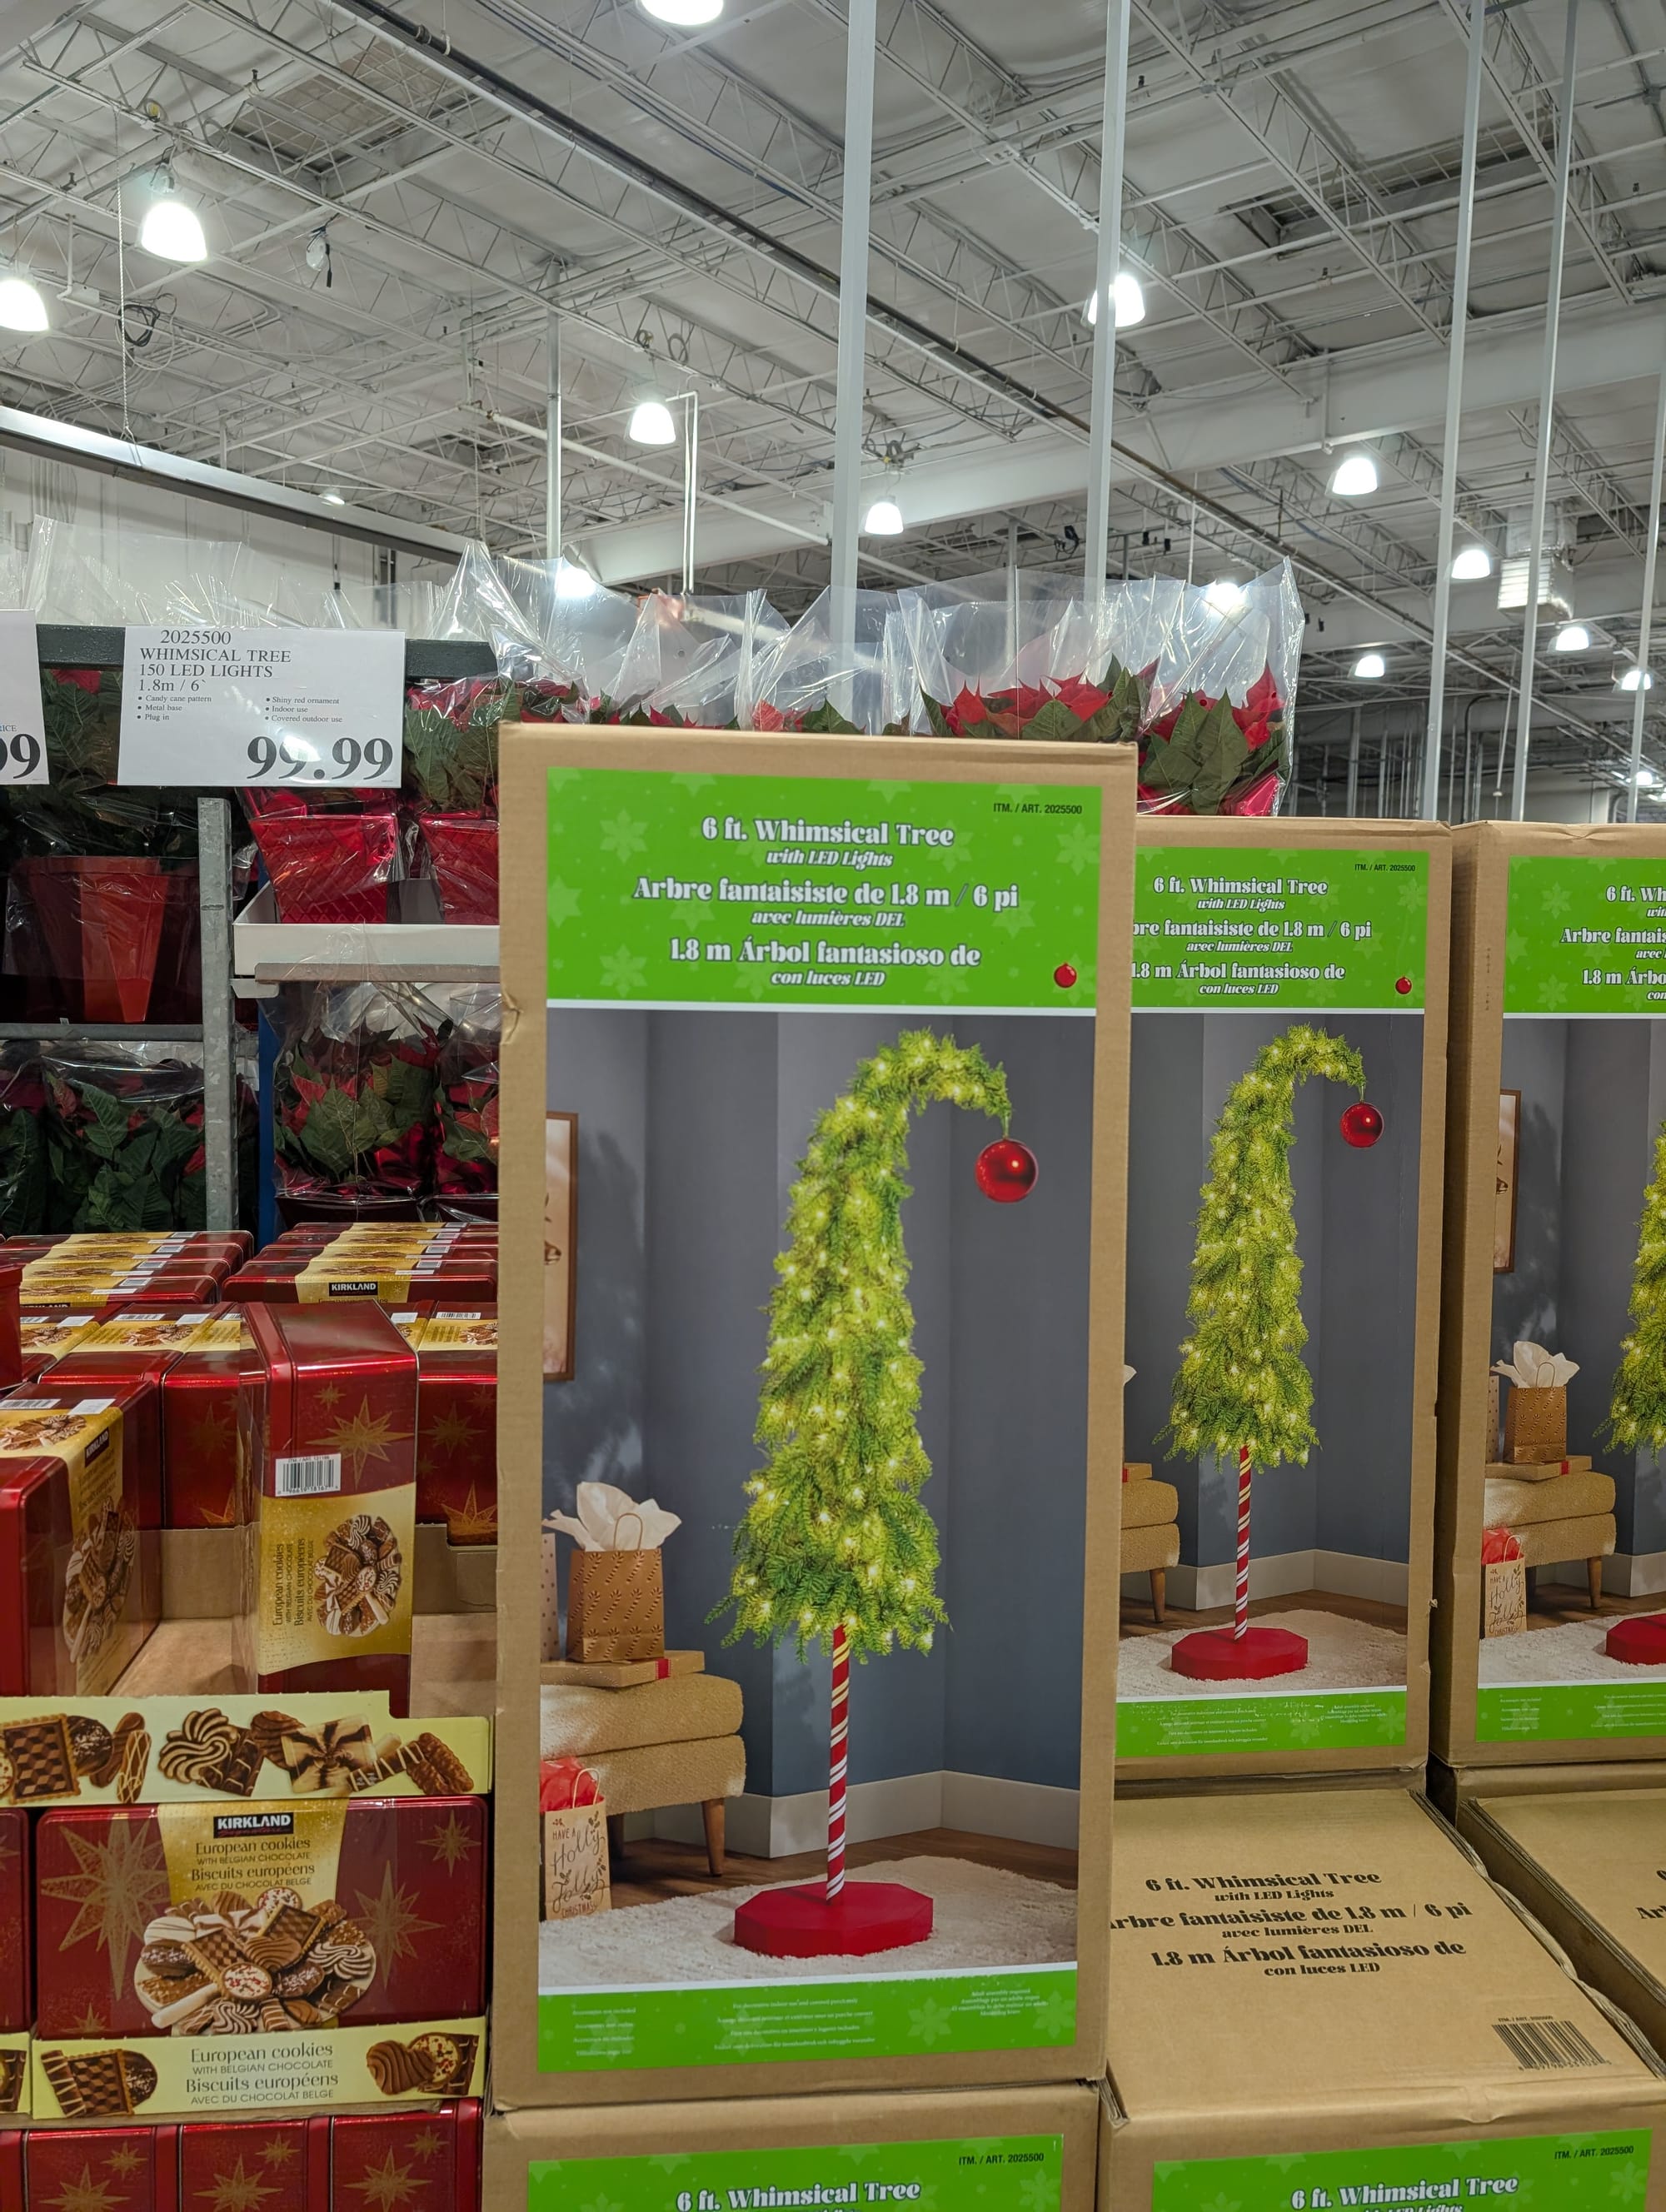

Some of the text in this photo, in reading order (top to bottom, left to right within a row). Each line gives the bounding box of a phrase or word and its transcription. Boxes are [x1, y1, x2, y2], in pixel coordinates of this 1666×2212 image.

[160, 630, 232, 645] 2025500
[140, 648, 292, 663] WHIMSICAL TREE
[140, 664, 272, 678] 150 LED LIGHTS
[139, 679, 174, 691] 1.8m
[145, 695, 167, 704] Candy
[187, 695, 212, 704] pattern
[272, 696, 292, 705] Shiny
[145, 714, 161, 722] Plug
[247, 736, 393, 780] 99.99
[993, 803, 1012, 813] ITM.
[1021, 804, 1041, 814] ART.
[1045, 805, 1082, 815] 2025500
[701, 816, 955, 847] 6 ft. Whimsical Tree
[766, 849, 894, 871] with LED Lights
[1153, 875, 1329, 895] 6 ft. Whimsical Tree
[1606, 885, 1635, 902] 6 ft.
[633, 876, 713, 901] Arbre
[718, 877, 848, 904] fantaisiste
[854, 882, 885, 906] de
[890, 883, 919, 906] 1.8
[925, 889, 950, 906] m
[972, 884, 989, 908] 6
[993, 884, 1019, 913] pi
[1197, 897, 1286, 913] with LED Lights
[751, 909, 905, 928] avec lumières DEL
[1164, 919, 1254, 937] fantaisiste
[1257, 920, 1279, 937] de
[1283, 920, 1304, 937] 1.8
[1306, 924, 1324, 937] m
[1339, 921, 1351, 938] 6
[1354, 920, 1372, 941] pi
[1559, 927, 1611, 944] Arbre
[669, 935, 982, 968] 1.8 m Árbol fantasioso de
[1186, 940, 1293, 953] avec lumières DEL
[1635, 949, 1662, 959] avec
[771, 969, 886, 987] con luces LED
[1154, 964, 1172, 979] m
[1176, 959, 1227, 979] Árbol
[1231, 962, 1320, 980] fantasioso
[1323, 962, 1346, 981] de
[1583, 969, 1622, 985] 1.8 m
[1199, 983, 1279, 995] con luces LED
[273, 1544, 285, 1626] European cookies
[294, 1590, 304, 1626] Biscuits
[217, 1815, 291, 1830] KIRKLAND
[552, 1828, 576, 1841] HAVE A
[196, 1836, 311, 1857] European cookies
[551, 1825, 605, 1876] Holly
[197, 1852, 312, 1866] WITH BELGIAN CHOCOLATE
[192, 1862, 315, 1881] Biscuits européens
[195, 1882, 218, 1891] AVEC
[235, 1879, 283, 1889] CHOCOLAT
[1145, 1873, 1382, 1891] 6 ft. Whimsical Tree
[1215, 1889, 1334, 1901] with LED Lights
[1179, 1909, 1307, 1926] fantaisiste
[1312, 1908, 1342, 1921] de
[1344, 1906, 1376, 1920] 1.8
[1379, 1906, 1407, 1919] m
[1424, 1903, 1442, 1916] 6
[1445, 1901, 1473, 1919] pi
[1221, 1924, 1373, 1939] avec lumières DEL
[1151, 1940, 1467, 1966] 1.8 m Árbol fantasioso de
[1264, 1962, 1380, 1976] con luces LED
[191, 2042, 333, 2065] European cookies
[192, 2060, 333, 2075] WITH BELGIAN CHOCOLATE
[187, 2073, 339, 2093] Biscuits européens
[191, 2090, 333, 2105] AVEC DU CHOCOLAT BELGE
[676, 2181, 921, 2212] 6 ft. Whimsical Tree
[1290, 2177, 1519, 2210] 6 ft. Whimsical Tree
